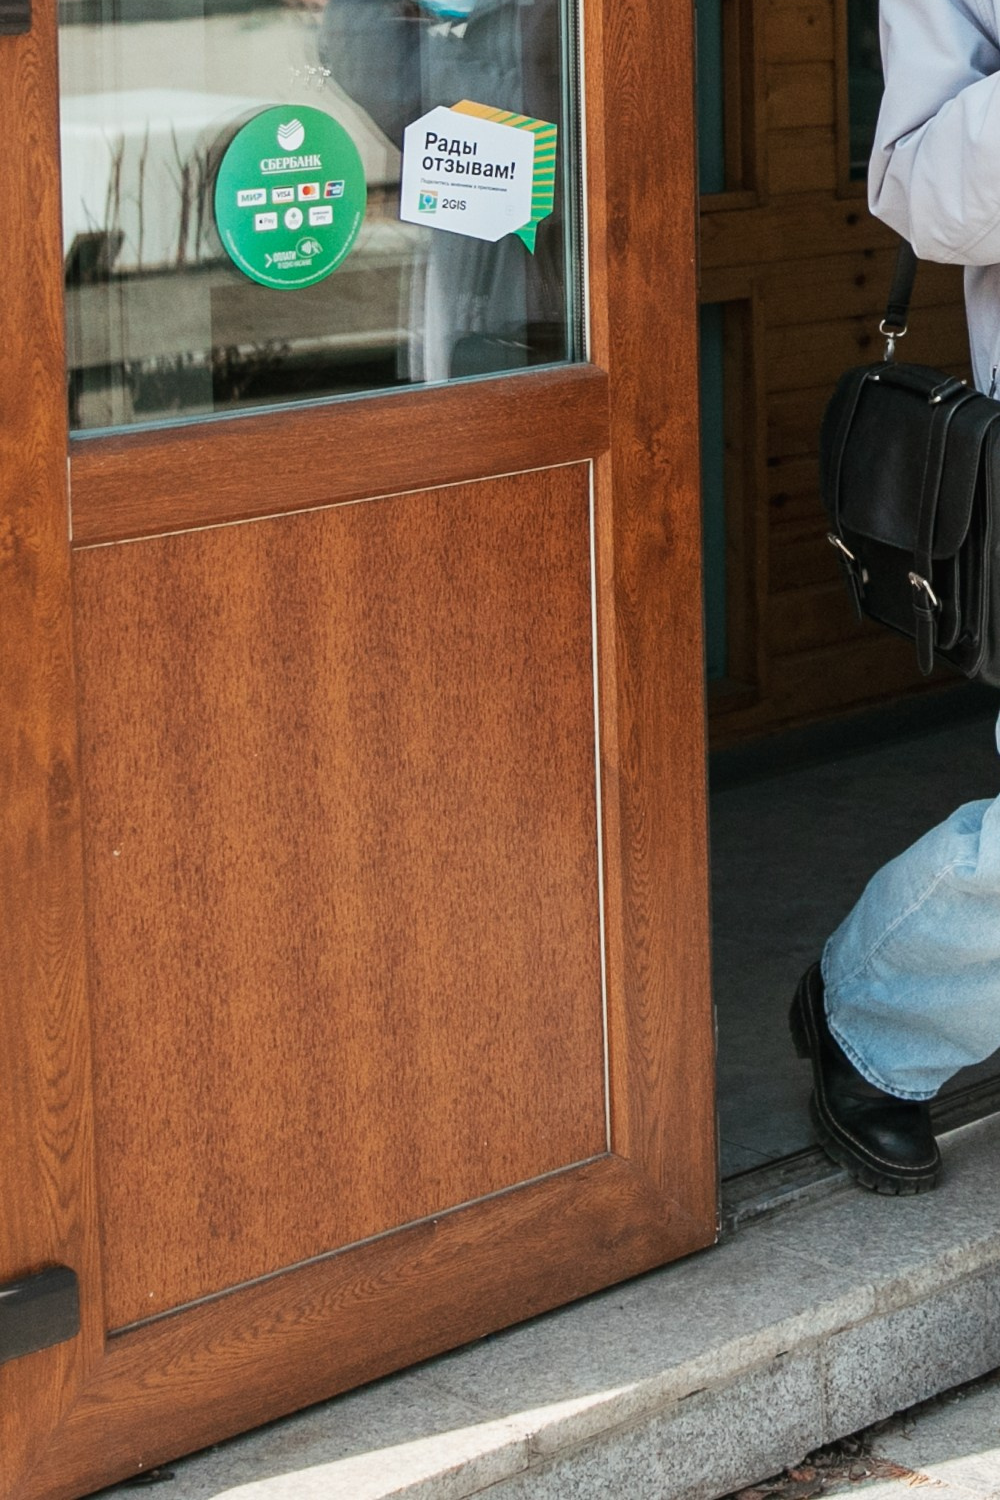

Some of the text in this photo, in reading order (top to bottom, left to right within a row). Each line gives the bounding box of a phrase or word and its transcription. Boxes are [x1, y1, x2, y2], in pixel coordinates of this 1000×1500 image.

[425, 132, 477, 156] Рады
[260, 154, 322, 172] СБЕРБАНК
[422, 156, 516, 179] отзывам!
[241, 192, 263, 203] МИР
[276, 190, 291, 199] VISA
[442, 198, 467, 210] 2GIS
